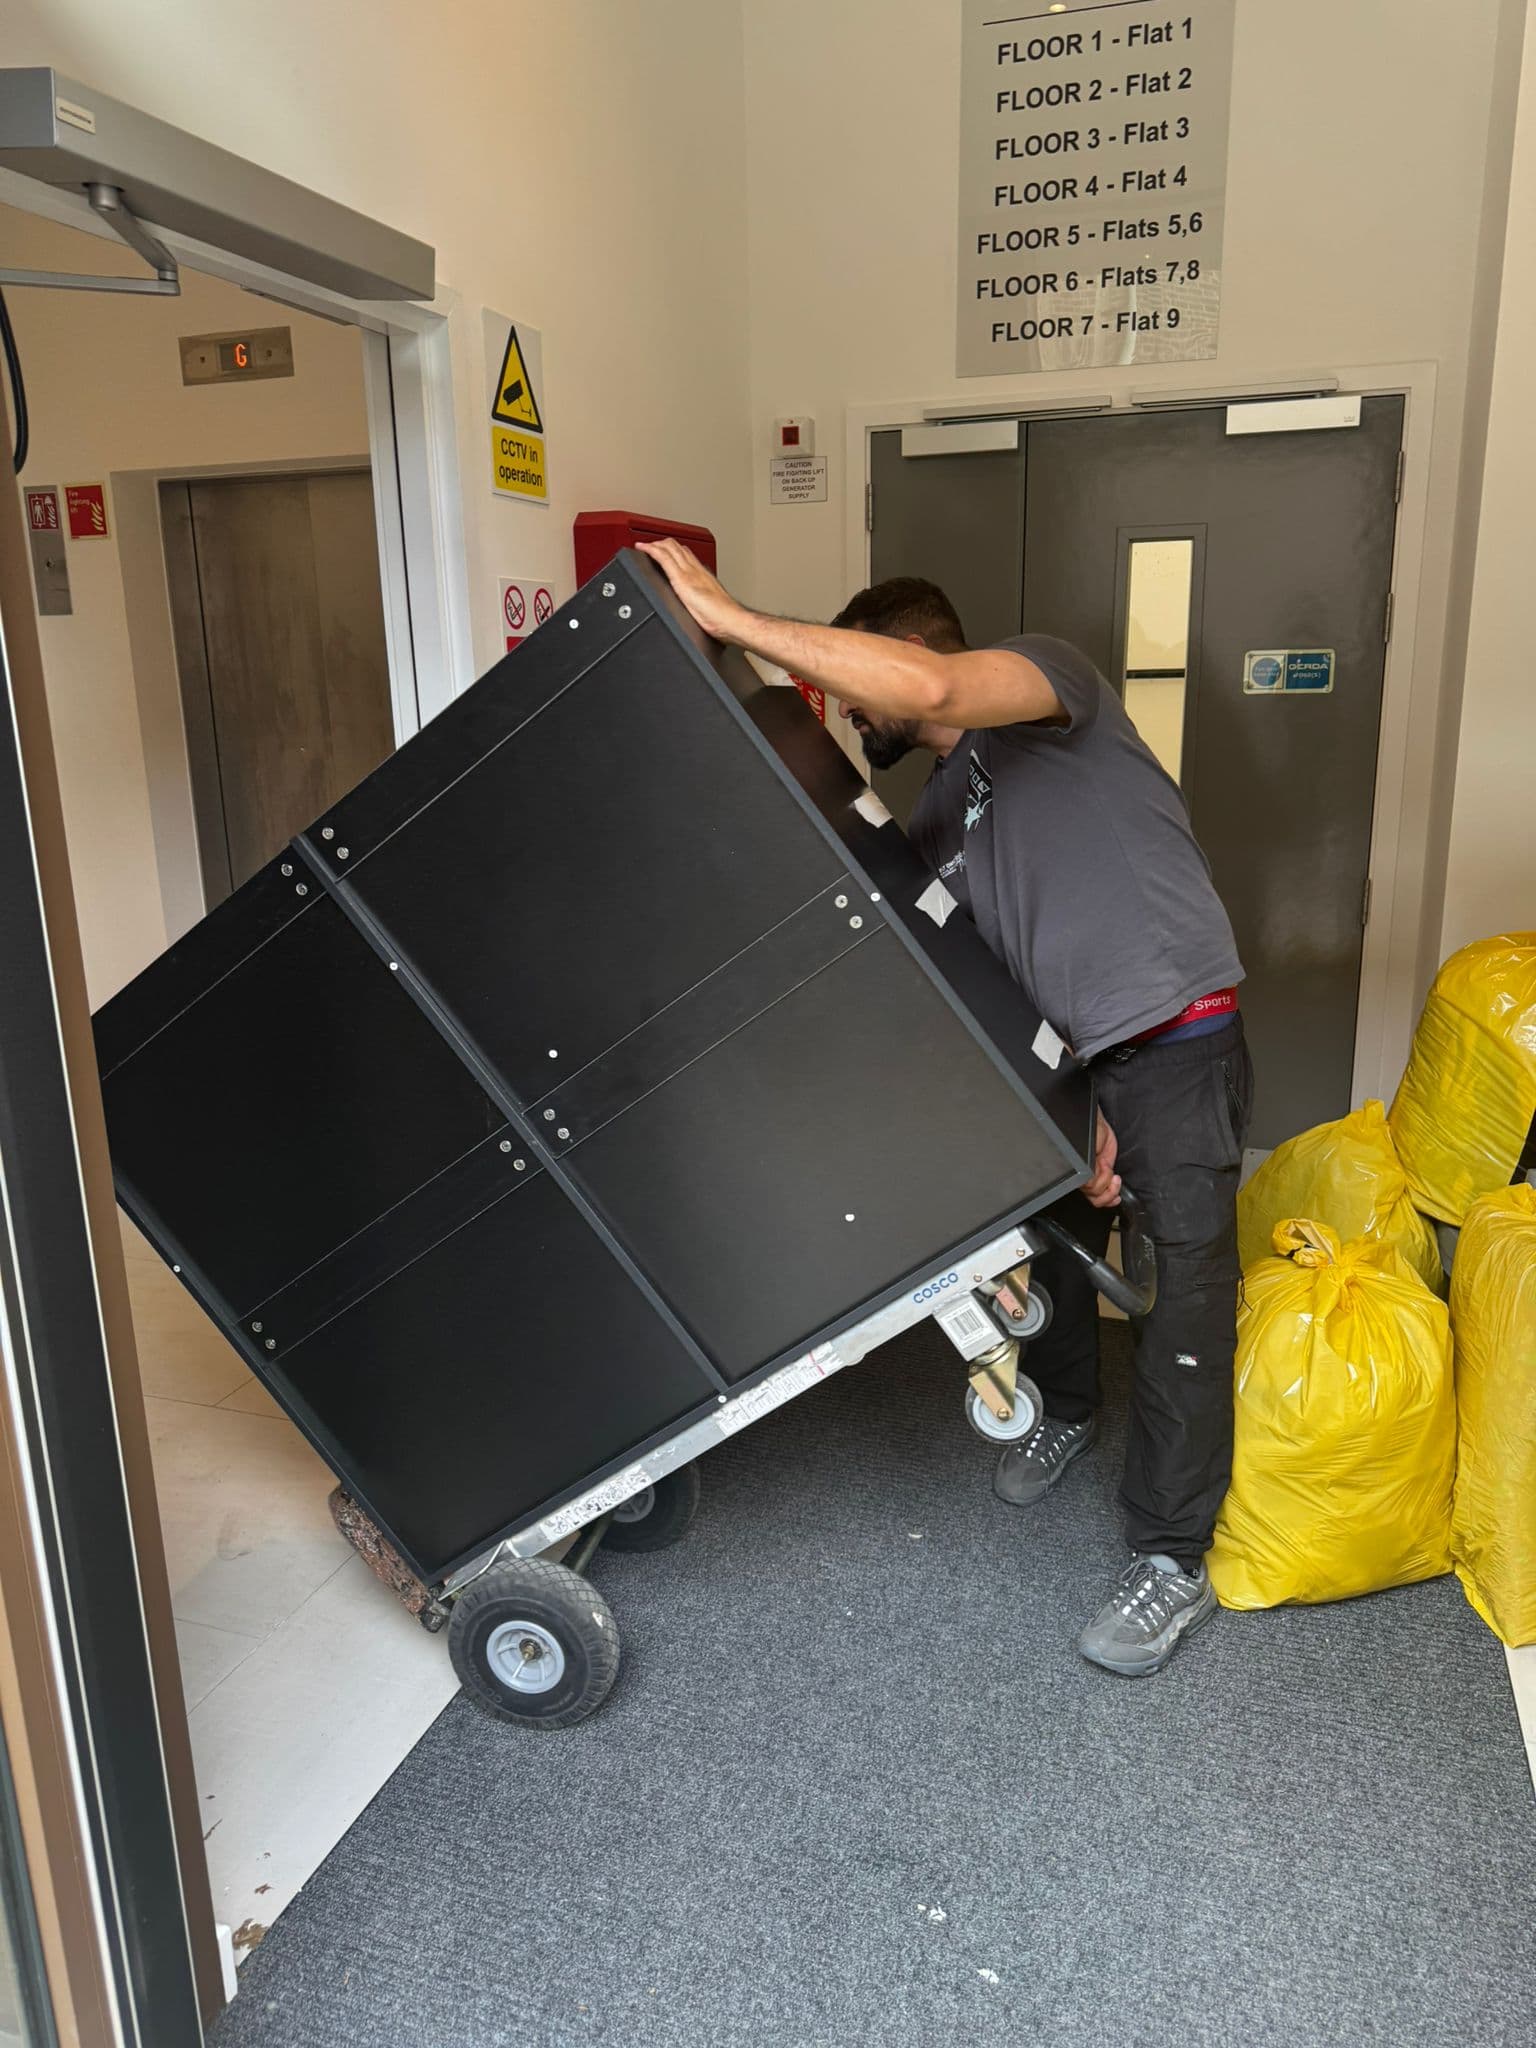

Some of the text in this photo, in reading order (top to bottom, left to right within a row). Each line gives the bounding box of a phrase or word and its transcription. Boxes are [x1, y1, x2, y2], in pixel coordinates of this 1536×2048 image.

[997, 34, 1083, 66] FLOOR
[1091, 30, 1102, 52] 1
[1127, 21, 1173, 47] Flat
[1182, 17, 1193, 39] 1
[996, 83, 1082, 113] FLOOR
[1088, 79, 1102, 101] 2
[1126, 71, 1171, 97] Flat
[1177, 67, 1192, 90] 2
[995, 131, 1080, 161] FLOOR
[1087, 127, 1100, 149] 3
[1124, 120, 1169, 145] Flat
[1175, 116, 1189, 139] 3
[994, 178, 1078, 207] FLOOR
[1085, 175, 1099, 196] 4
[1122, 168, 1167, 193] Flat
[1172, 165, 1188, 187] 4
[977, 226, 1060, 255] FLOOR
[1067, 224, 1080, 246] 5
[1103, 218, 1160, 242] Flats
[1167, 211, 1203, 238] 5,6
[976, 273, 1058, 300] FLOOR
[1065, 271, 1079, 292] 6
[1101, 265, 1158, 289] Flats
[1166, 259, 1200, 285] 7,8
[991, 317, 1074, 343] FLOOR
[1081, 315, 1094, 335] 7
[1116, 310, 1160, 333] Flat
[1167, 308, 1180, 329] 9
[235, 343, 247, 367] G
[500, 437, 538, 463] CCTV in
[785, 461, 812, 469] CAUTION
[499, 465, 543, 487] operation
[1194, 995, 1231, 1011] Sports
[913, 1272, 959, 1304] COSCO
